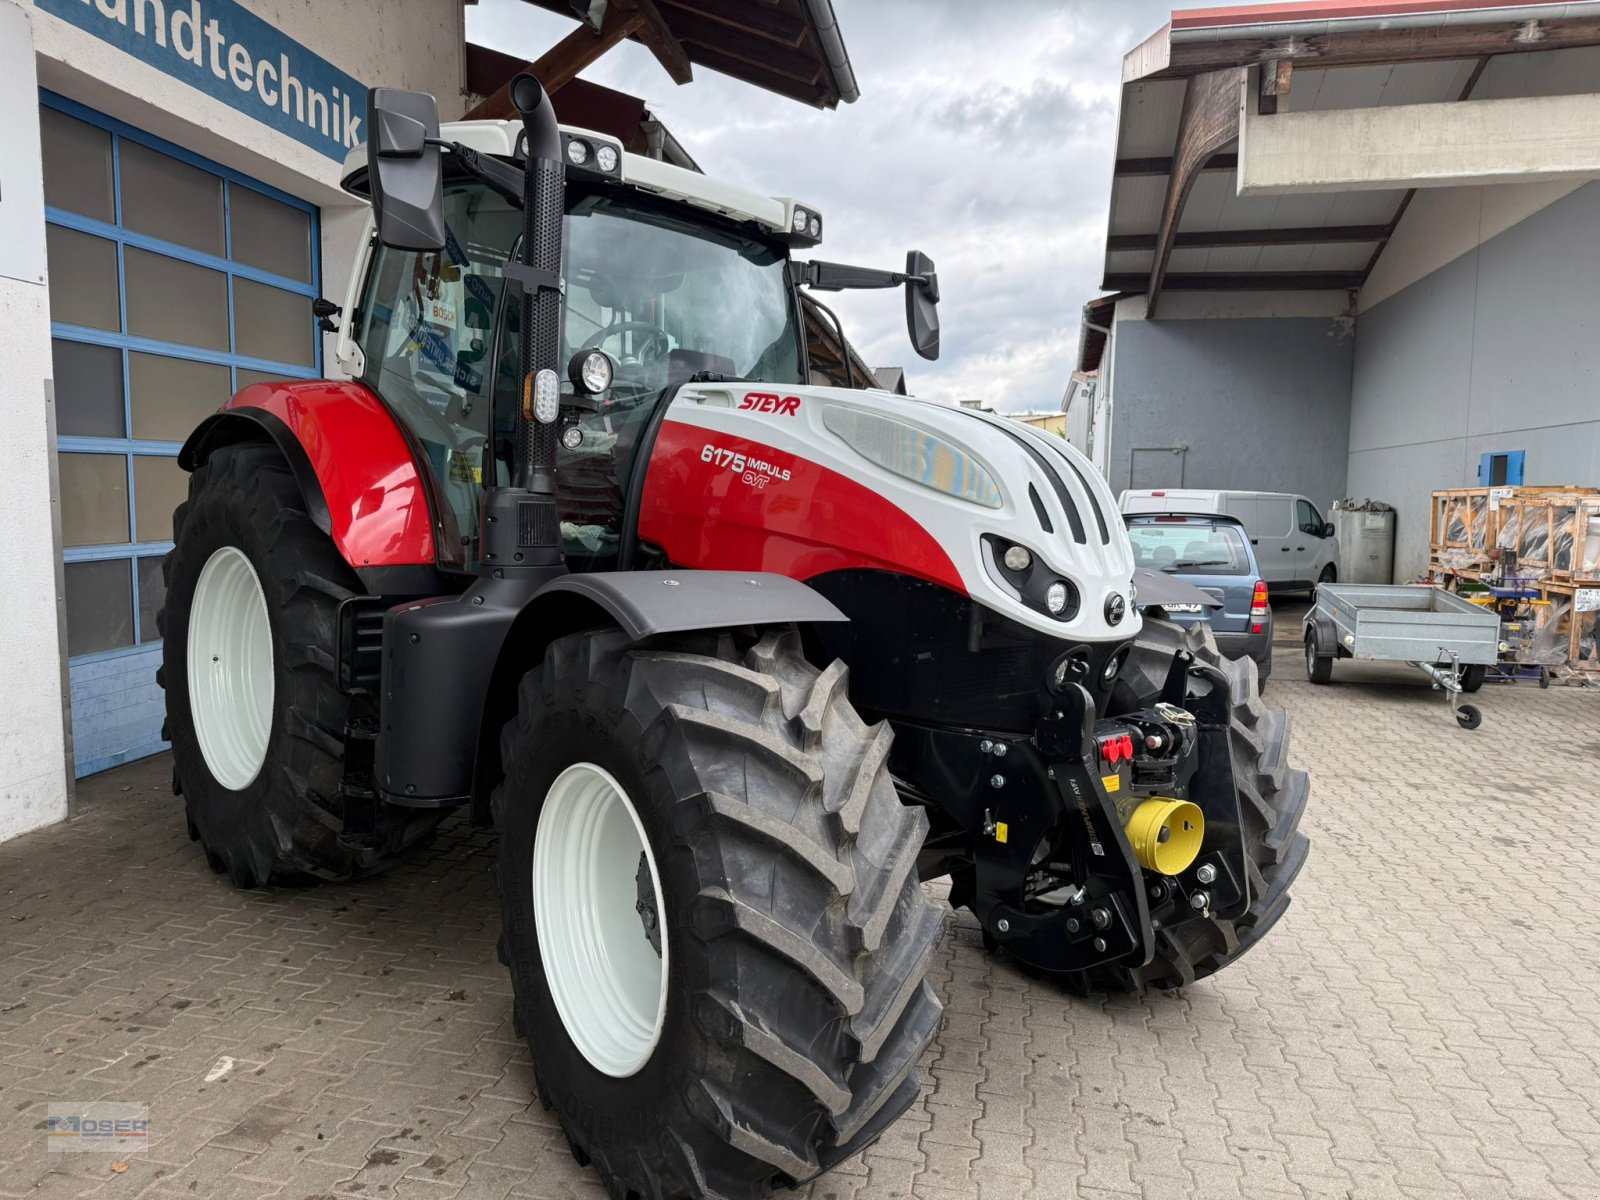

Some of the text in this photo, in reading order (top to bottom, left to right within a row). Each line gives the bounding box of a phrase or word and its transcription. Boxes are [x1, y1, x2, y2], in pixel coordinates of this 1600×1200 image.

[80, 0, 362, 149] ndtechnik
[737, 392, 801, 416] STEYR
[700, 444, 791, 480] 6175 IMPULS
[742, 470, 770, 489] CVT
